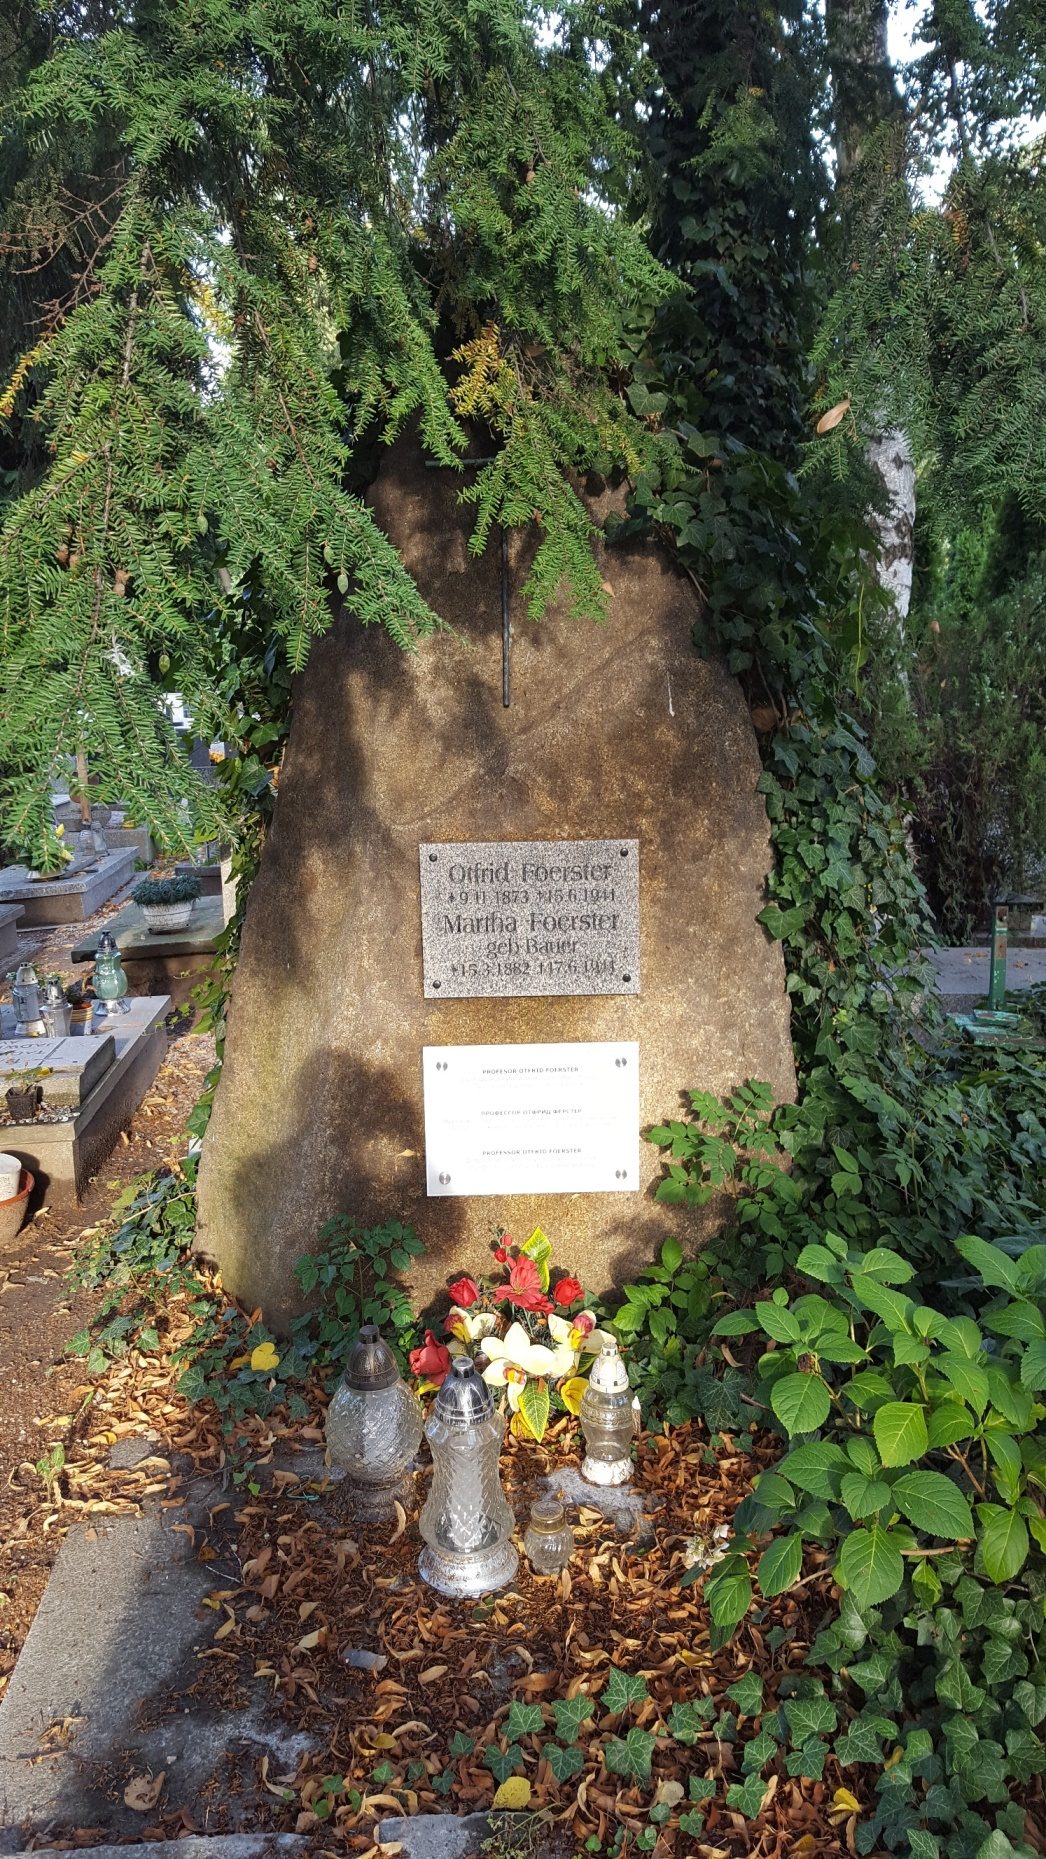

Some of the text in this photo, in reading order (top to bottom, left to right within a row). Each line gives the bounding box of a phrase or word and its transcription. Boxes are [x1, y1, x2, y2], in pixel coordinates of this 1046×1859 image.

[448, 862, 612, 884] Otfrid Foerster
[443, 911, 620, 935] Martha Foerster
[525, 938, 579, 954] Bauer
